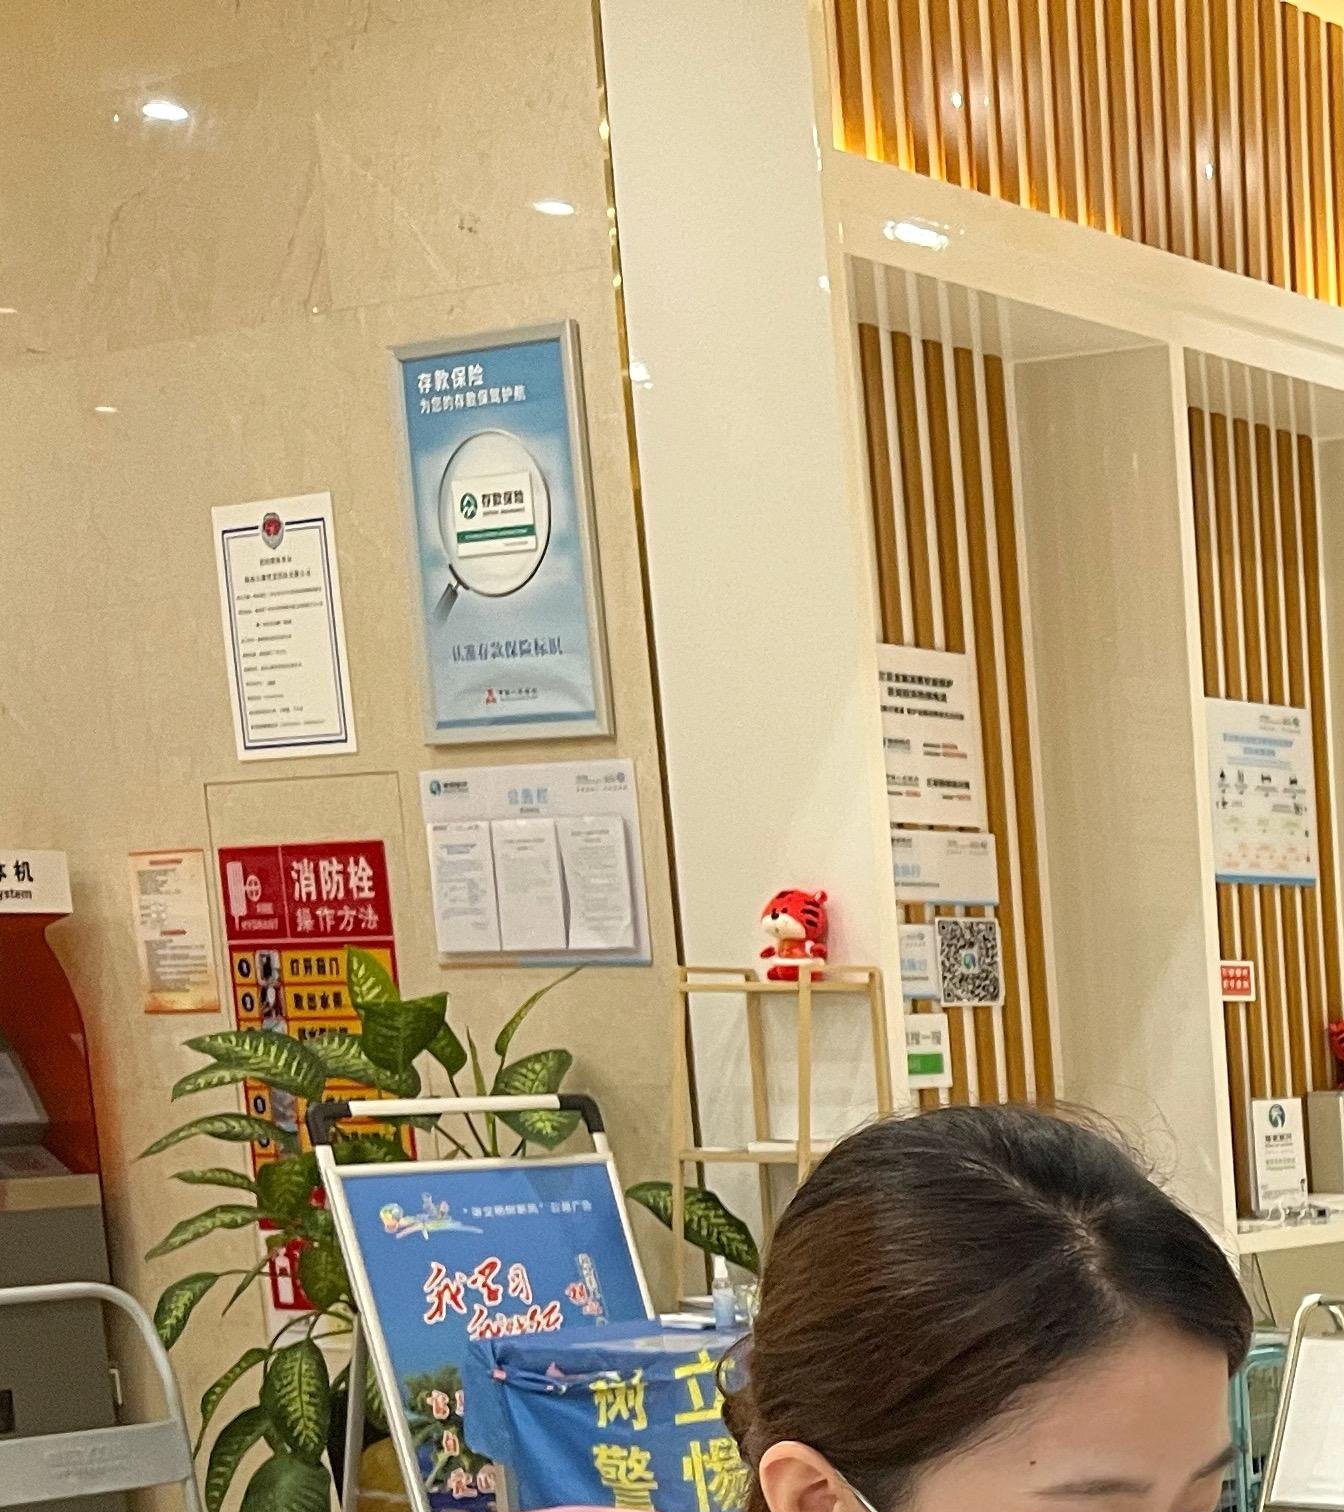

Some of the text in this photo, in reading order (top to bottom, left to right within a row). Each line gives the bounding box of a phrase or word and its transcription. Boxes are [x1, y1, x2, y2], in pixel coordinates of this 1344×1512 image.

[417, 363, 484, 394] 存款保险
[291, 856, 376, 902] 消防栓
[296, 904, 379, 933] 操作方法
